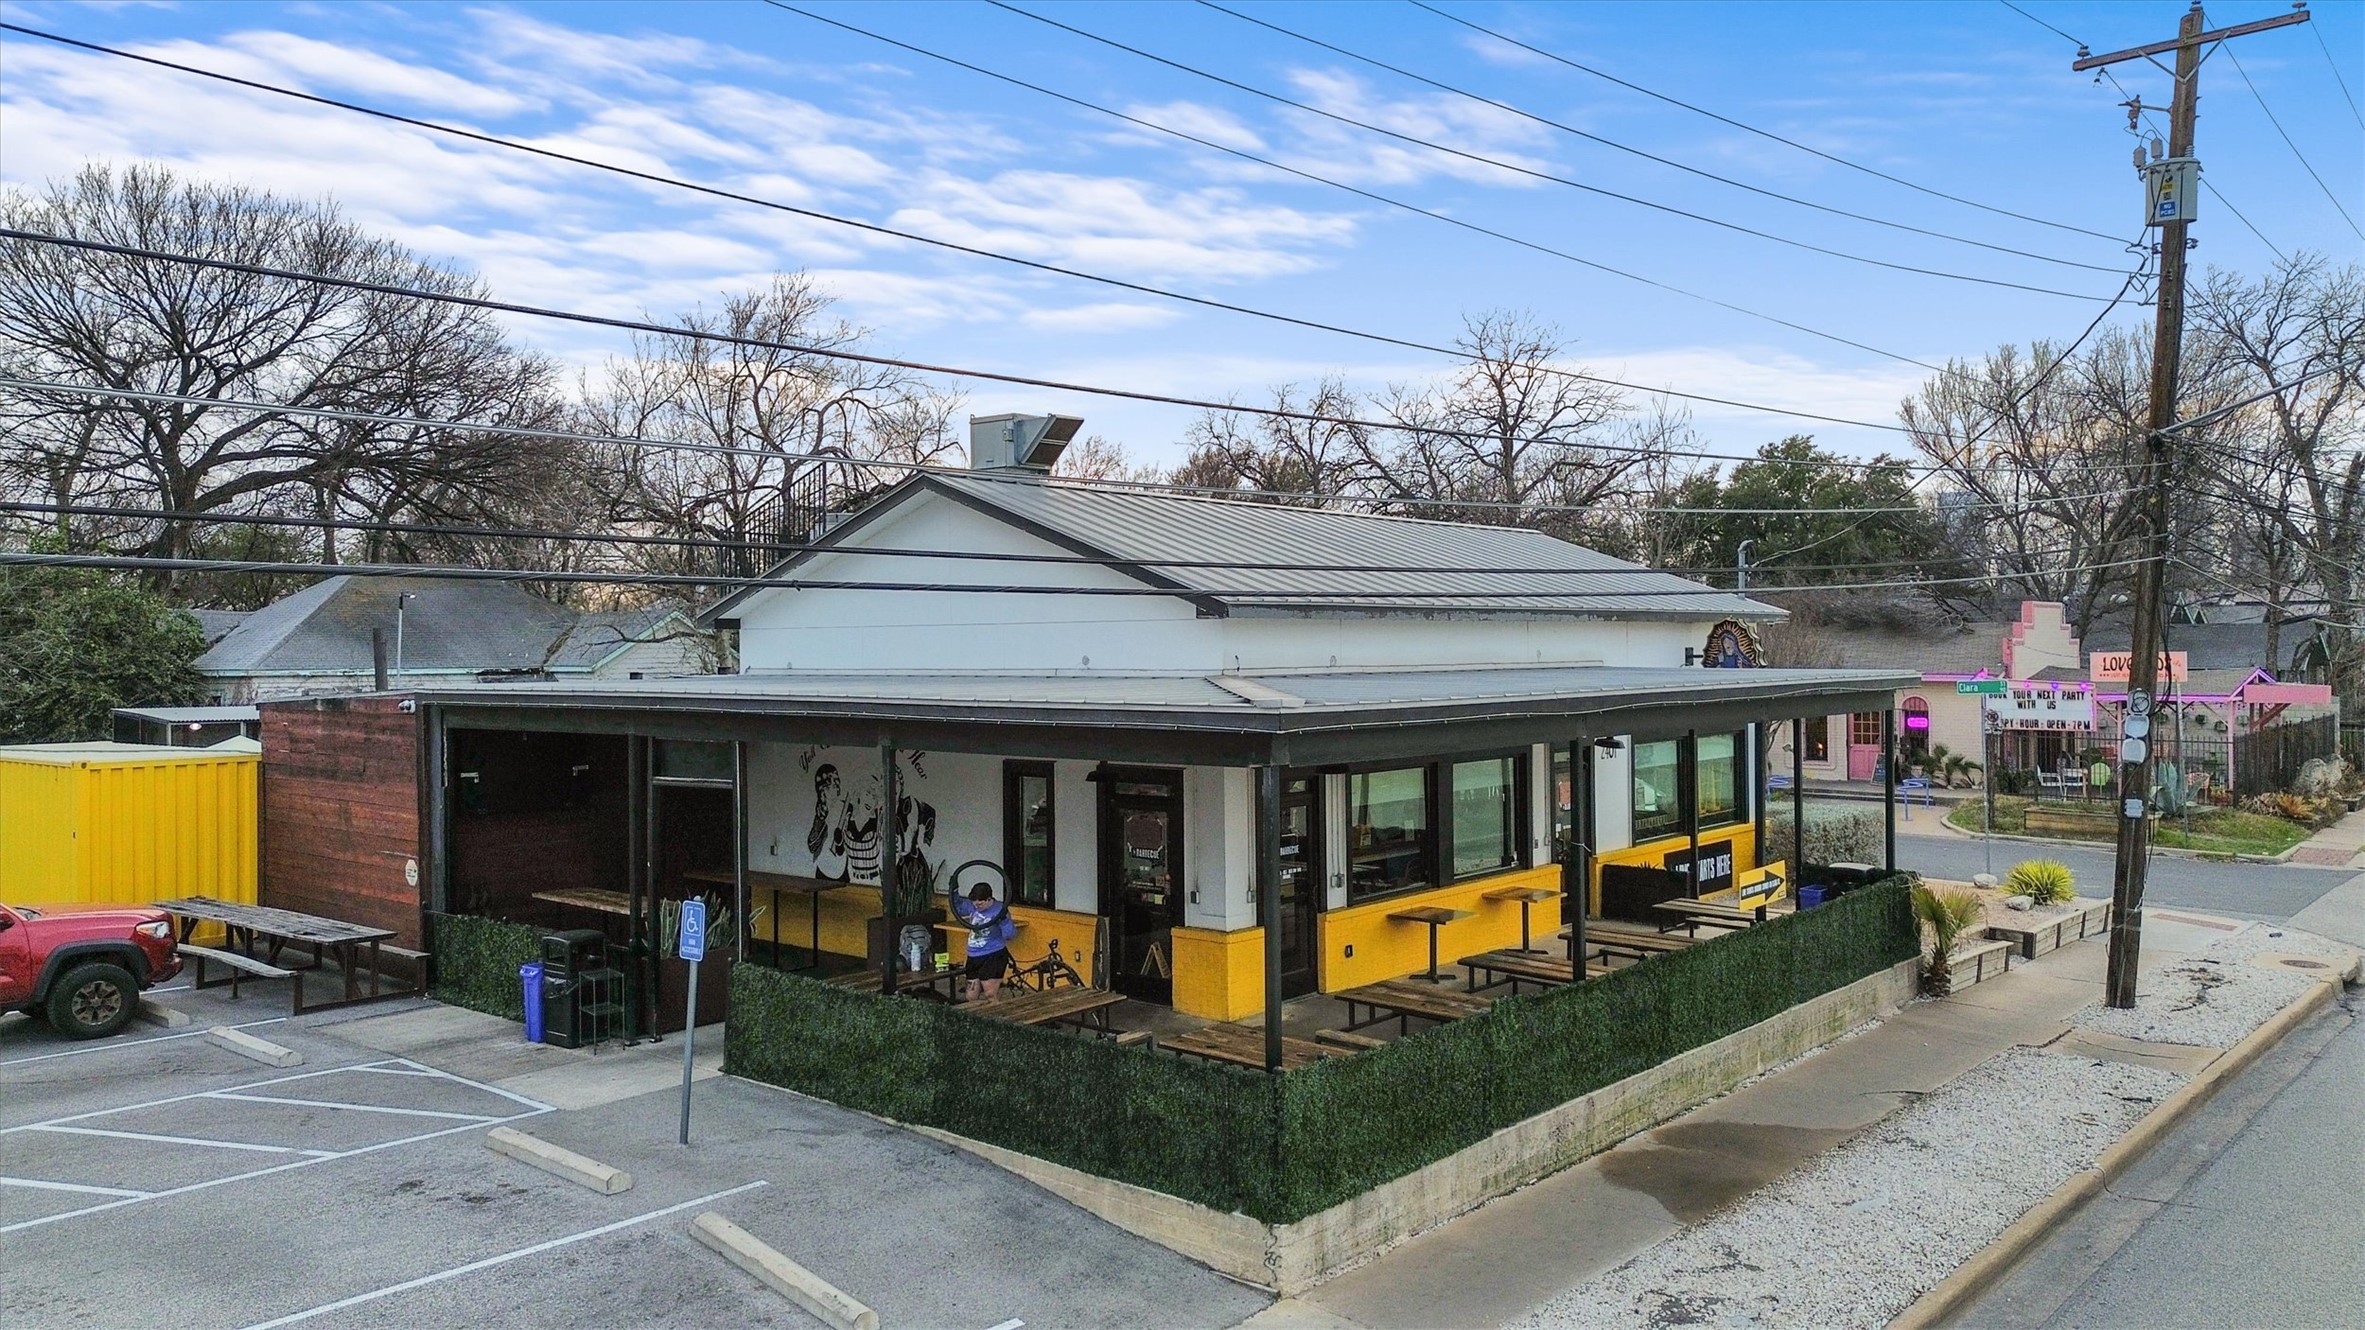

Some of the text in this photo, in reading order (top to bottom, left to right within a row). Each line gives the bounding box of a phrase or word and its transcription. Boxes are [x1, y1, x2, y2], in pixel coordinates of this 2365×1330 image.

[1958, 683, 1979, 692] Clara
[2013, 690, 2032, 700] YOUR
[2037, 690, 2056, 700] NEXT
[2062, 690, 2085, 700] PARTY
[2017, 700, 2056, 709] WITH US
[1716, 853, 1731, 877] HERE
